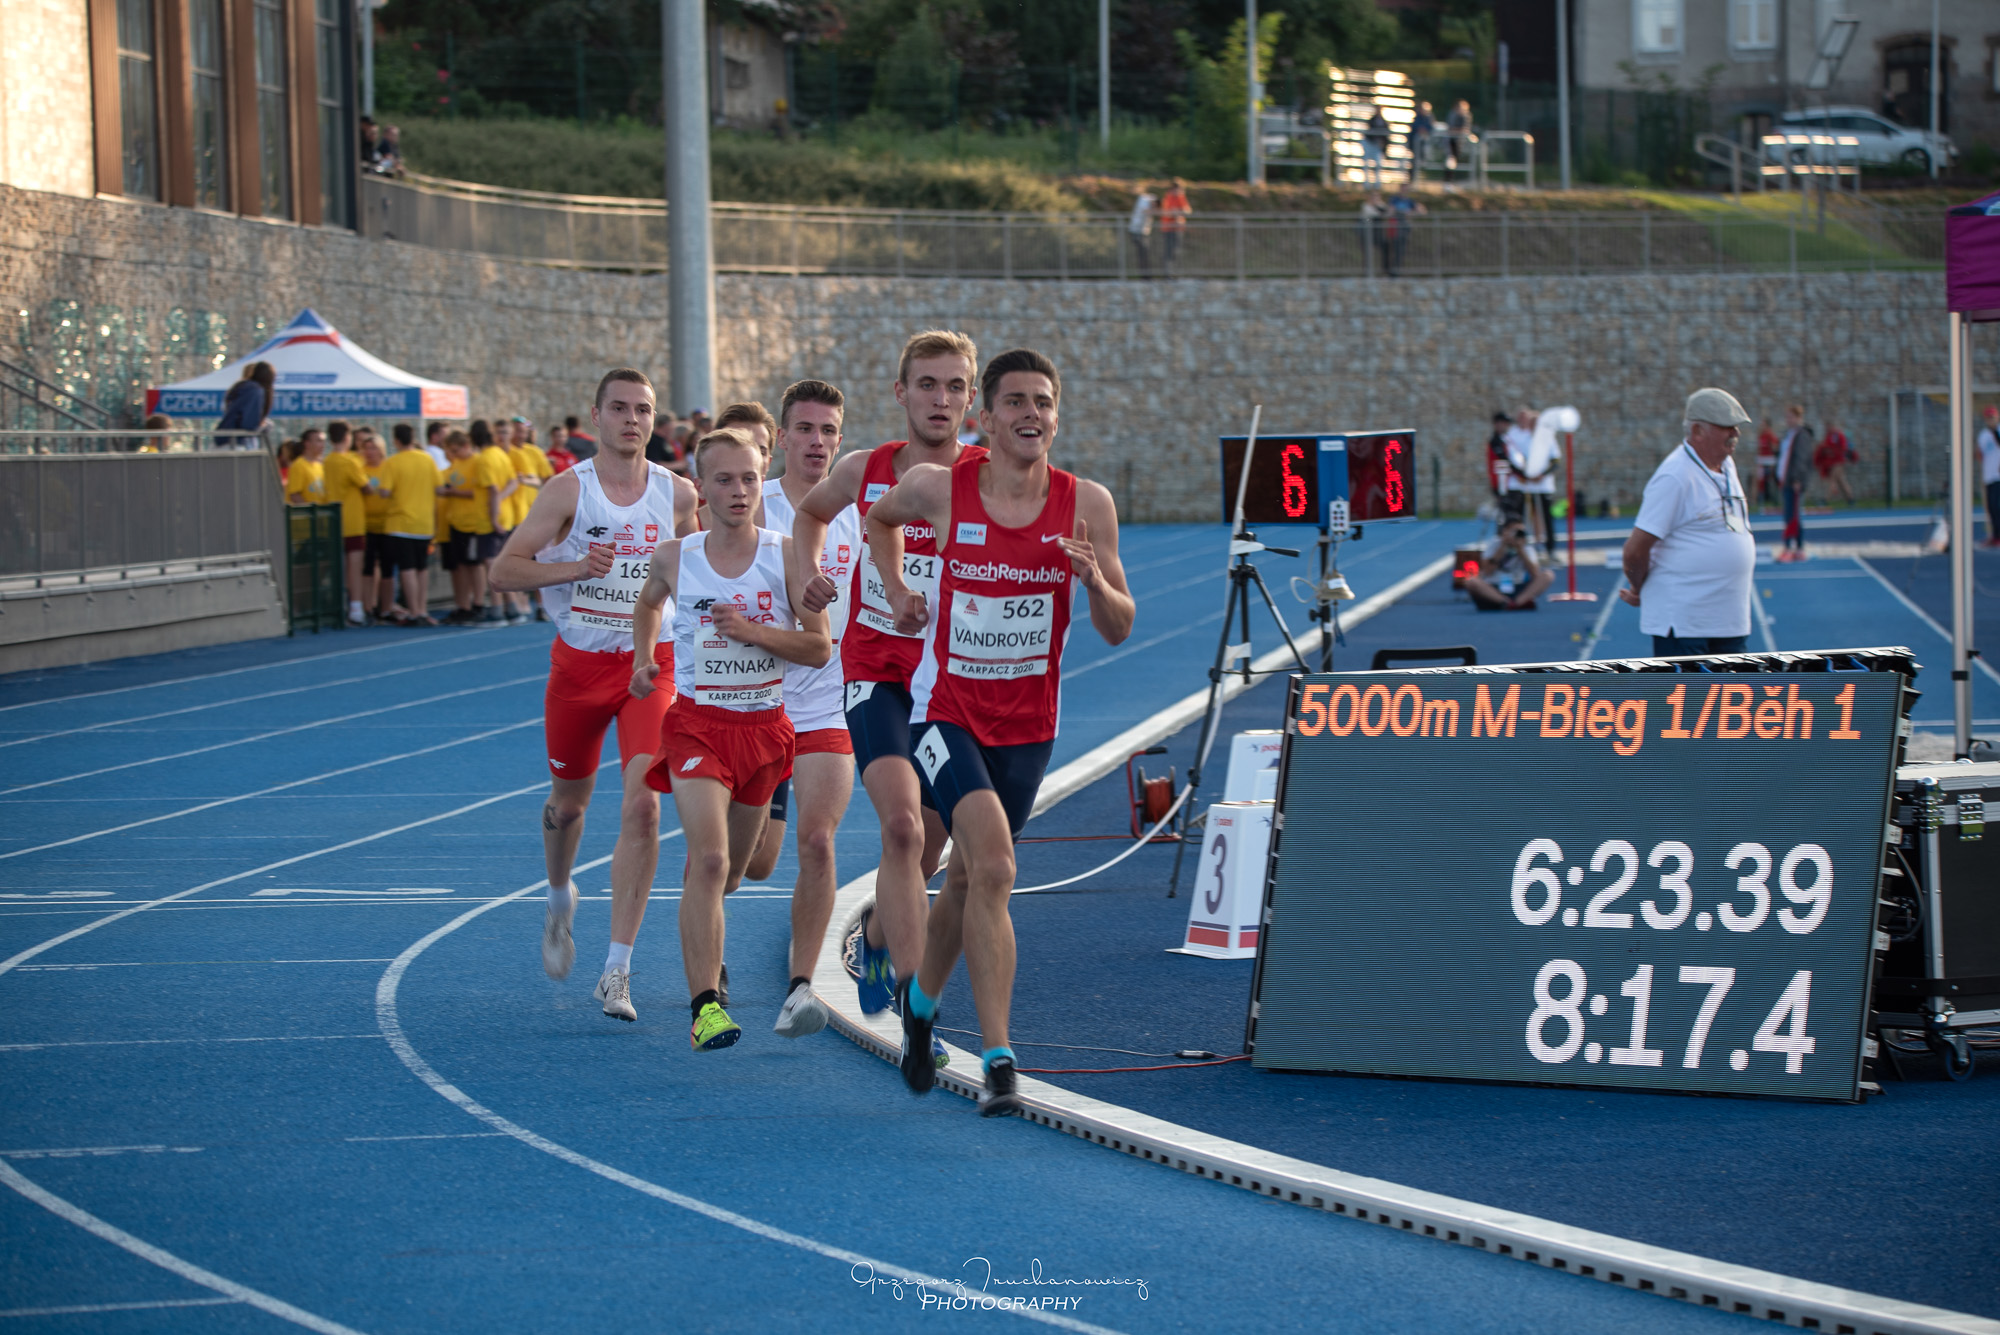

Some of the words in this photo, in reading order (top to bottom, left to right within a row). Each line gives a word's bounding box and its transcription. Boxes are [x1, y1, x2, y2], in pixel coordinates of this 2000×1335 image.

[161, 392, 217, 412] CZECH
[303, 391, 406, 412] FEDERATION
[1281, 444, 1308, 517] 6
[1385, 440, 1404, 512] 6
[586, 526, 609, 538] 4F
[588, 541, 657, 556] PLSKA
[949, 559, 1066, 584] CzechRepublic
[576, 583, 641, 604] MICHALS
[1003, 598, 1045, 619] 562
[581, 615, 622, 628] KARPACZ
[700, 613, 775, 626] PKA
[955, 627, 1048, 648] VANDROVEC
[705, 657, 776, 675] SZYNAKA
[961, 663, 1010, 675] KARPACZ
[1012, 662, 1034, 675] 2020
[708, 691, 753, 701] KARPACZ
[754, 688, 773, 700] 2020
[853, 680, 862, 699] 5
[1297, 684, 1460, 737] 5000m
[1471, 684, 1648, 756] M-Bieg
[1660, 683, 1814, 740] 1/Běh
[1828, 683, 1861, 740] 1
[924, 744, 937, 769] 3
[1205, 833, 1228, 915] 3
[1510, 838, 1834, 934] 6:23.39
[1525, 959, 1816, 1074] 8:17.4
